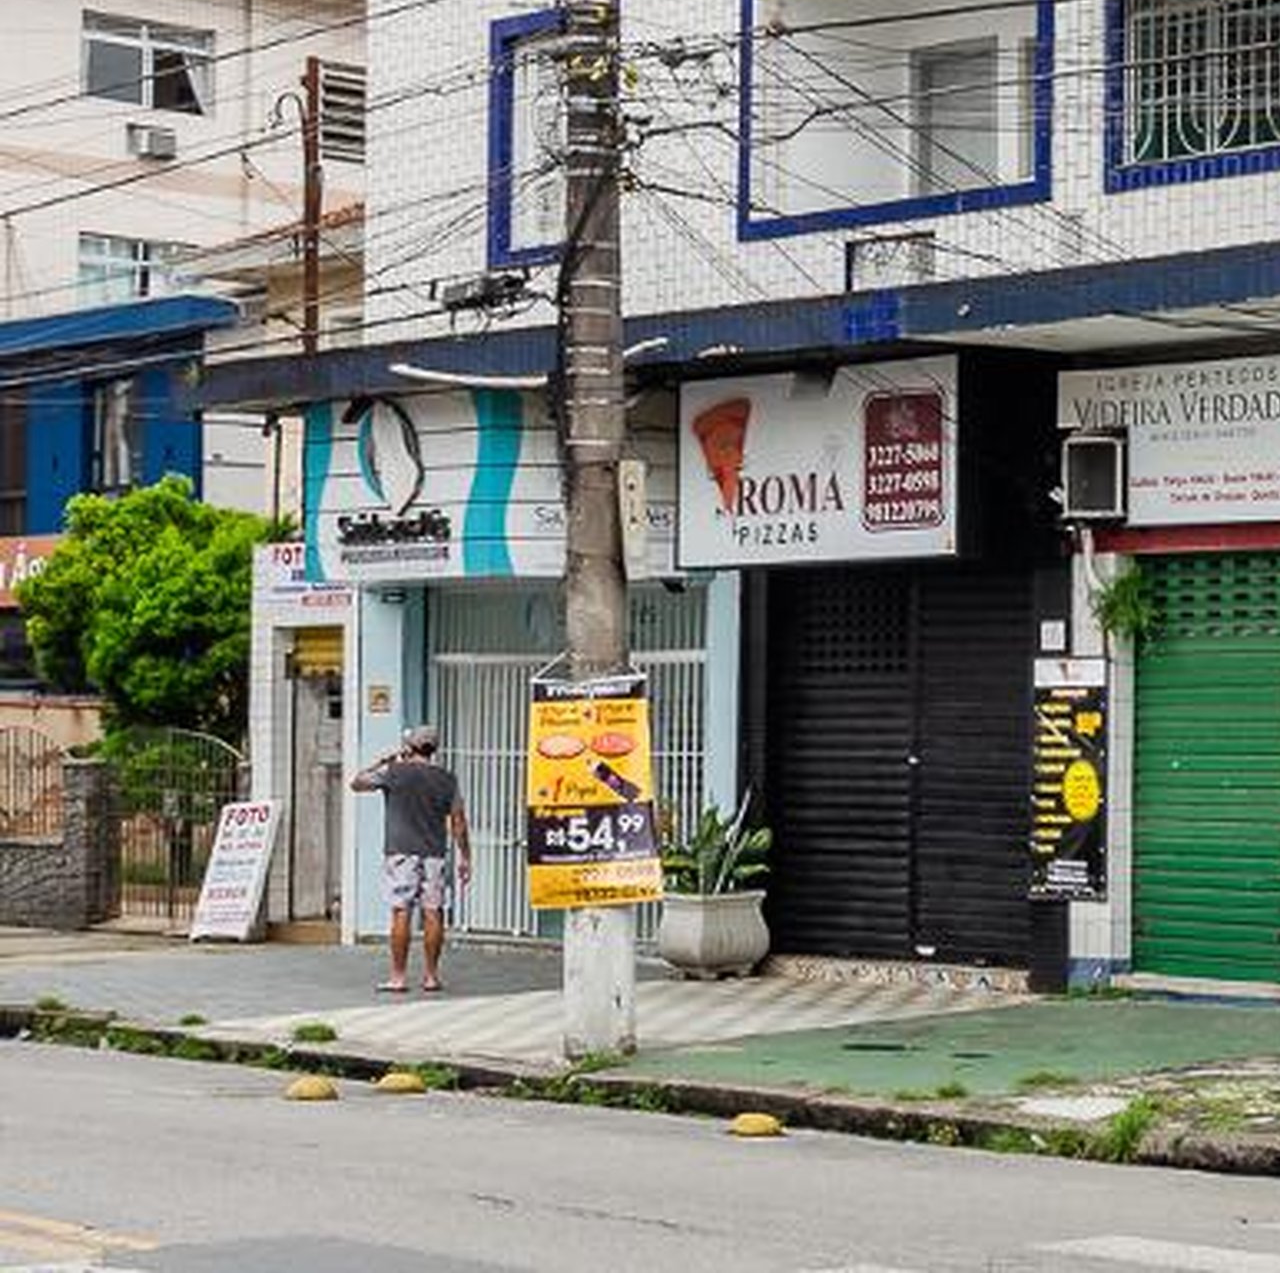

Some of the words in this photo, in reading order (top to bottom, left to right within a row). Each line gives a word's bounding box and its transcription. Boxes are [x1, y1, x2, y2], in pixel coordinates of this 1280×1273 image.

[1096, 375, 1164, 392] IGREJA
[1072, 398, 1172, 426] VIDEIRA
[737, 471, 844, 517] ROMA
[737, 521, 820, 546] PIZZAS
[273, 546, 303, 565] FOT
[225, 806, 270, 826] FOTO
